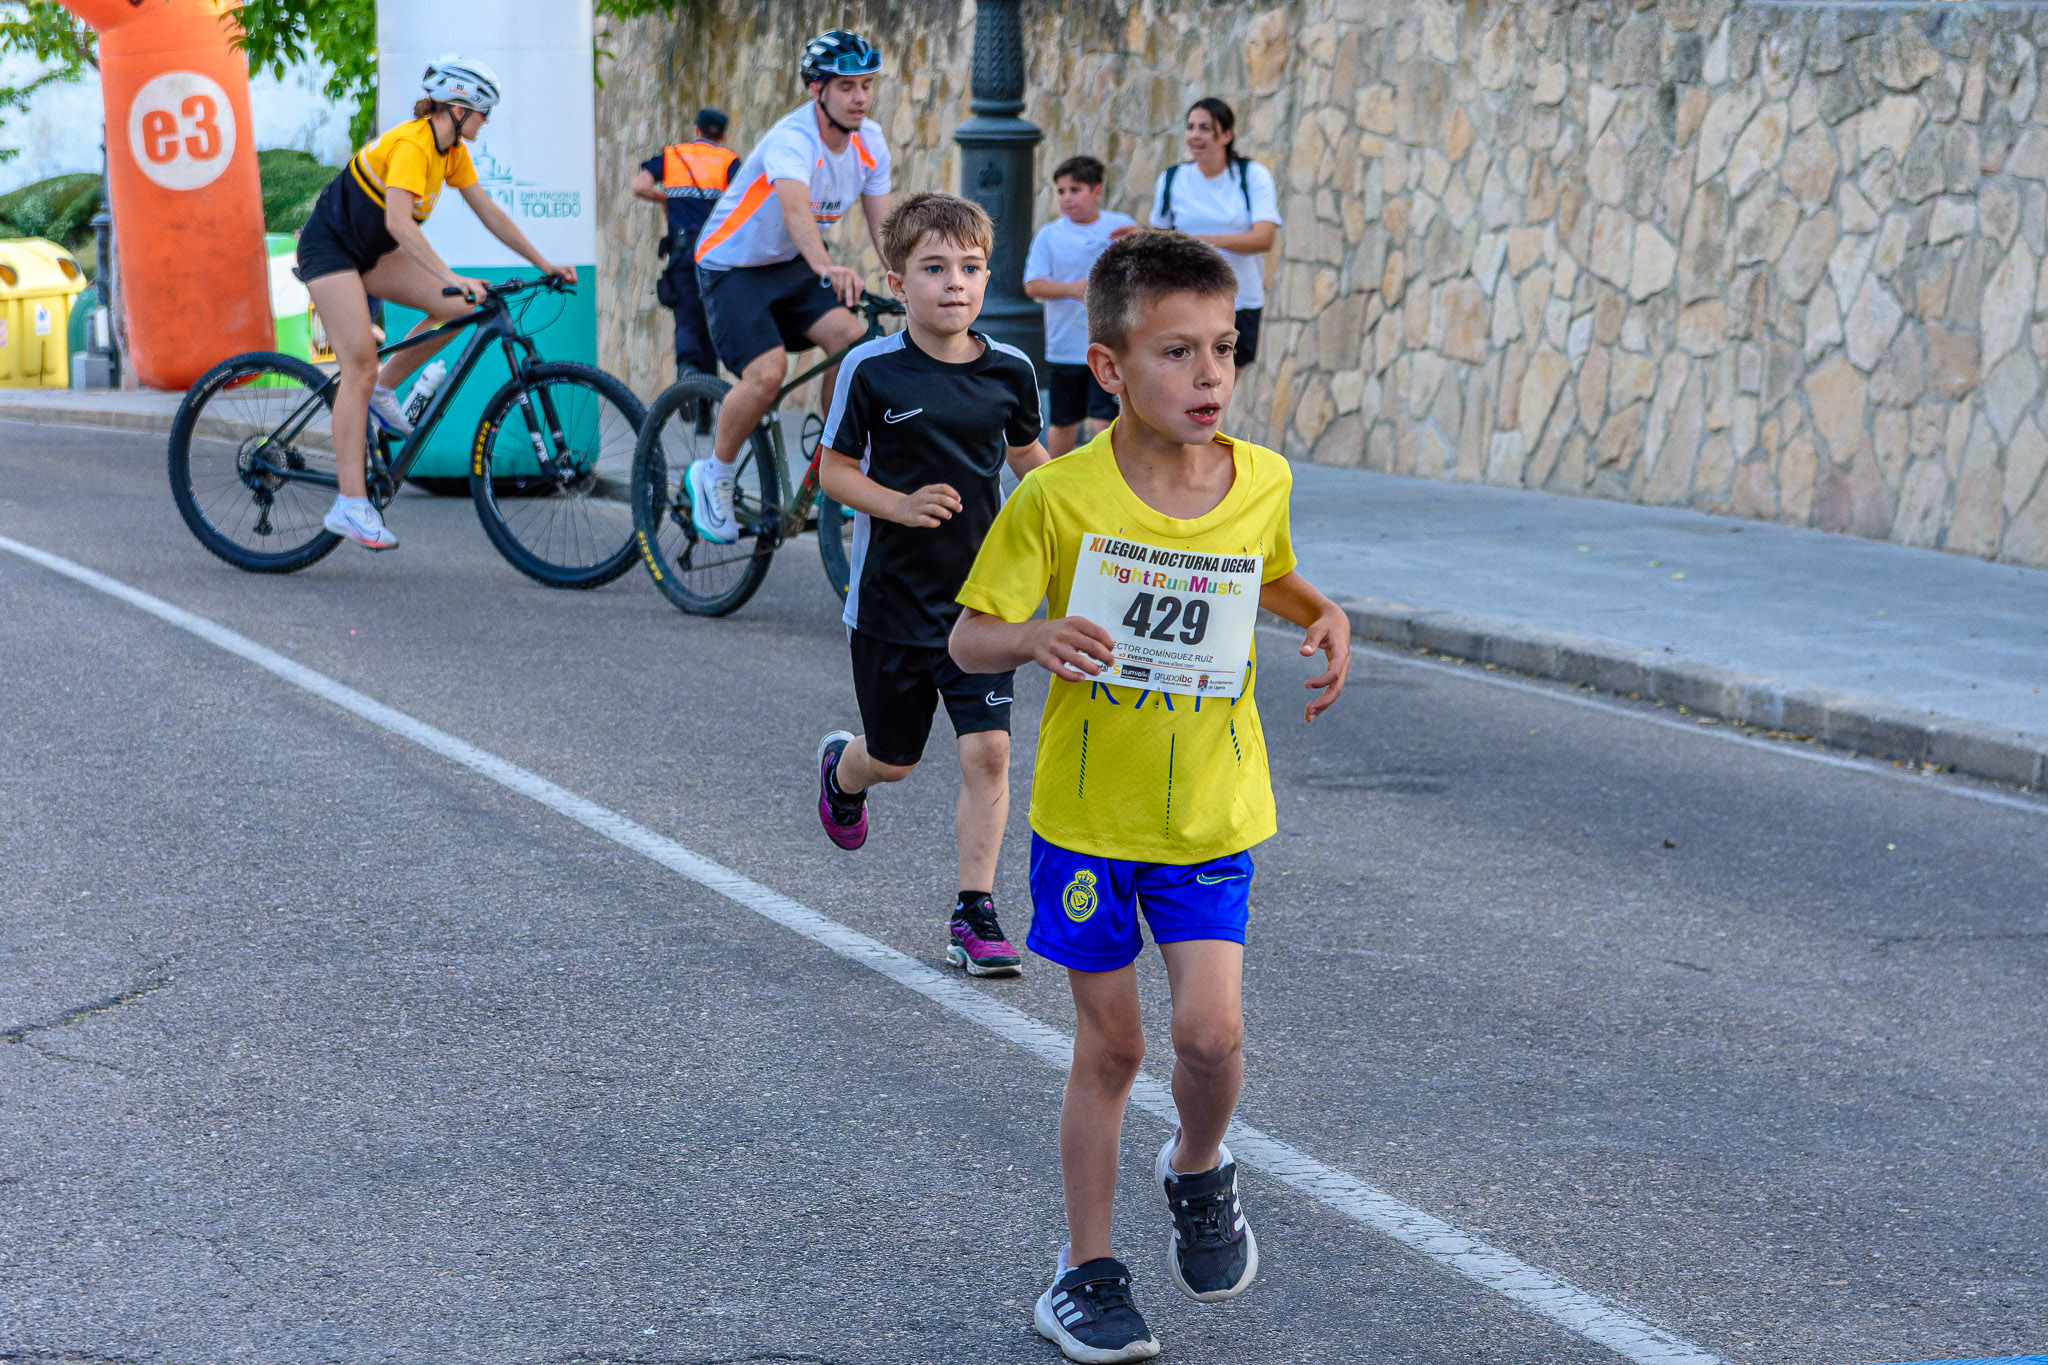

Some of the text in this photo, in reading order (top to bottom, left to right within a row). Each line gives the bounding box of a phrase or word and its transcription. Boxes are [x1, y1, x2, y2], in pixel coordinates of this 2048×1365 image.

[142, 94, 222, 164] e3
[520, 202, 582, 218] TOLEDO
[1089, 537, 1256, 573] XI LEGUA NOCTURNA UGENA
[1122, 591, 1210, 645] 429
[1127, 654, 1153, 663] EVENTOS
[1142, 647, 1194, 662] DOMÍNGUEZ
[1194, 655, 1214, 663] RUÍZ
[1154, 672, 1193, 683] grupoibc
